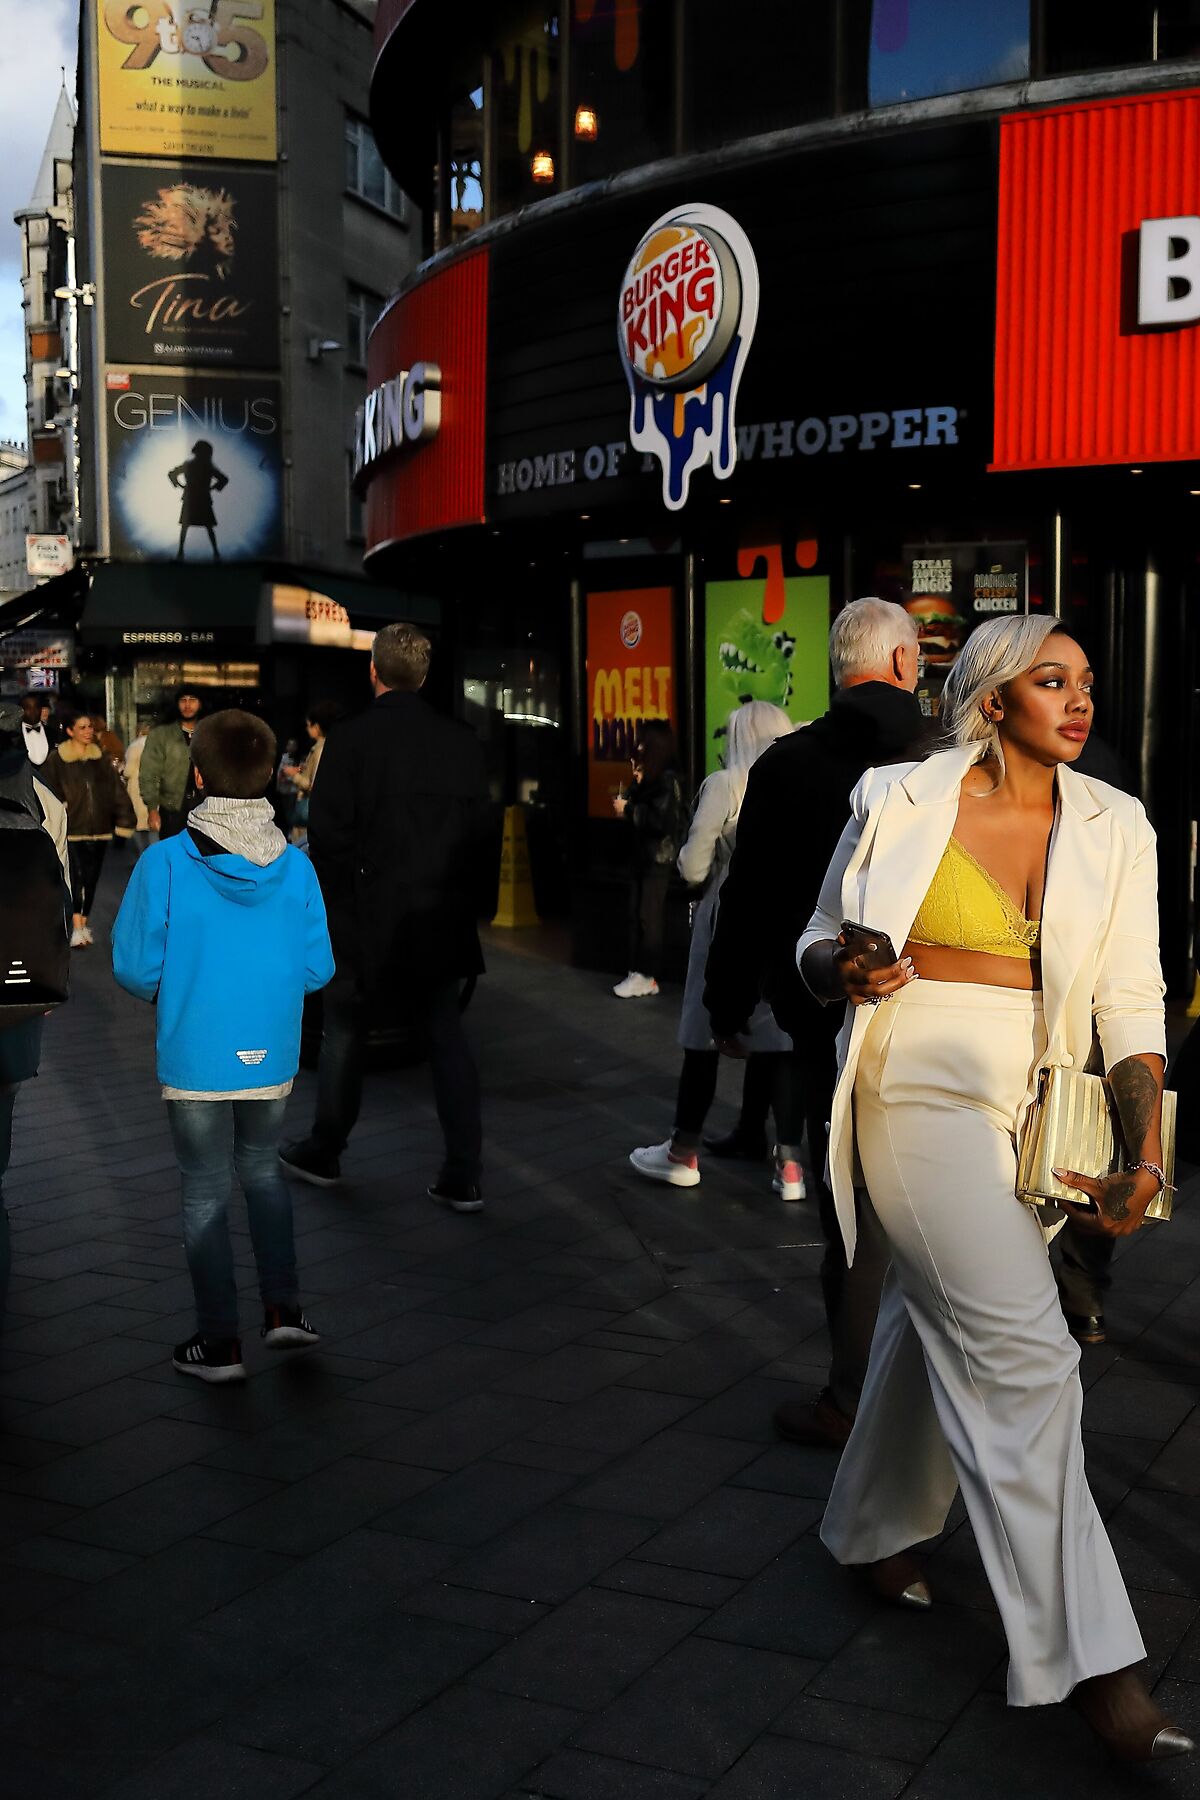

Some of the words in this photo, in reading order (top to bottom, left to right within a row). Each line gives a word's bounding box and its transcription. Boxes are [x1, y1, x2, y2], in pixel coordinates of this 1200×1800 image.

[104, 0, 170, 69] 9
[201, 0, 268, 81] 5
[152, 77, 172, 88] THE
[176, 79, 225, 91] MUSICAL
[168, 105, 184, 116] way
[623, 239, 710, 322] BURGER
[130, 272, 251, 334] Tina
[626, 267, 715, 366] KING
[114, 392, 277, 434] GENIUS
[364, 362, 441, 465] KING
[737, 406, 958, 461] WHOPPER
[499, 450, 575, 494] HOME
[584, 441, 626, 479] OF
[912, 560, 952, 569] STEAK
[912, 579, 952, 592] ANGUS
[913, 569, 952, 579] HOUSE
[974, 587, 1018, 598] CRISPY
[974, 598, 1018, 611] CHICKEN
[123, 632, 182, 643] ESPRESSO
[191, 632, 214, 643] BAR
[594, 667, 671, 722] MELT
